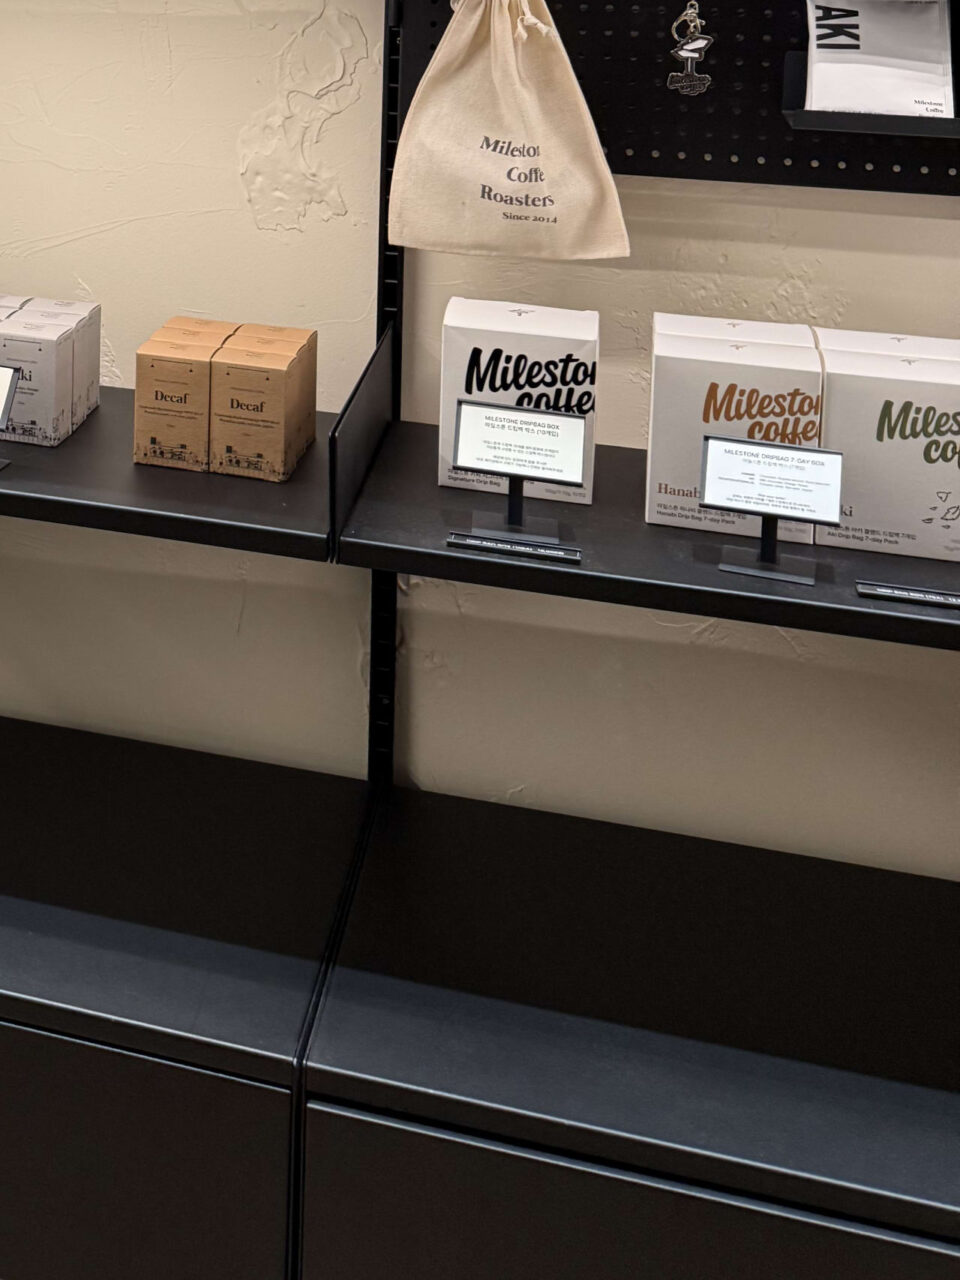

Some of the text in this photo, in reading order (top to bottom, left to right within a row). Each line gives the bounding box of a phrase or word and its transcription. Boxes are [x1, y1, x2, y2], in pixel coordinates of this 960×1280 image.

[814, 4, 861, 50] AKI
[480, 183, 556, 208] Roasters
[502, 211, 558, 224] Since 2014
[18, 367, 32, 382] ki
[154, 390, 190, 405] Decaf
[229, 398, 266, 413] Decaf
[484, 415, 519, 425] MILESTONE
[519, 420, 546, 429] DRIPBAG
[724, 448, 760, 459] MILESTONE
[475, 478, 489, 486] Drip
[657, 482, 702, 499] Hanab
[840, 505, 853, 518] ki
[837, 532, 851, 540] Drip
[851, 534, 864, 542] Bag
